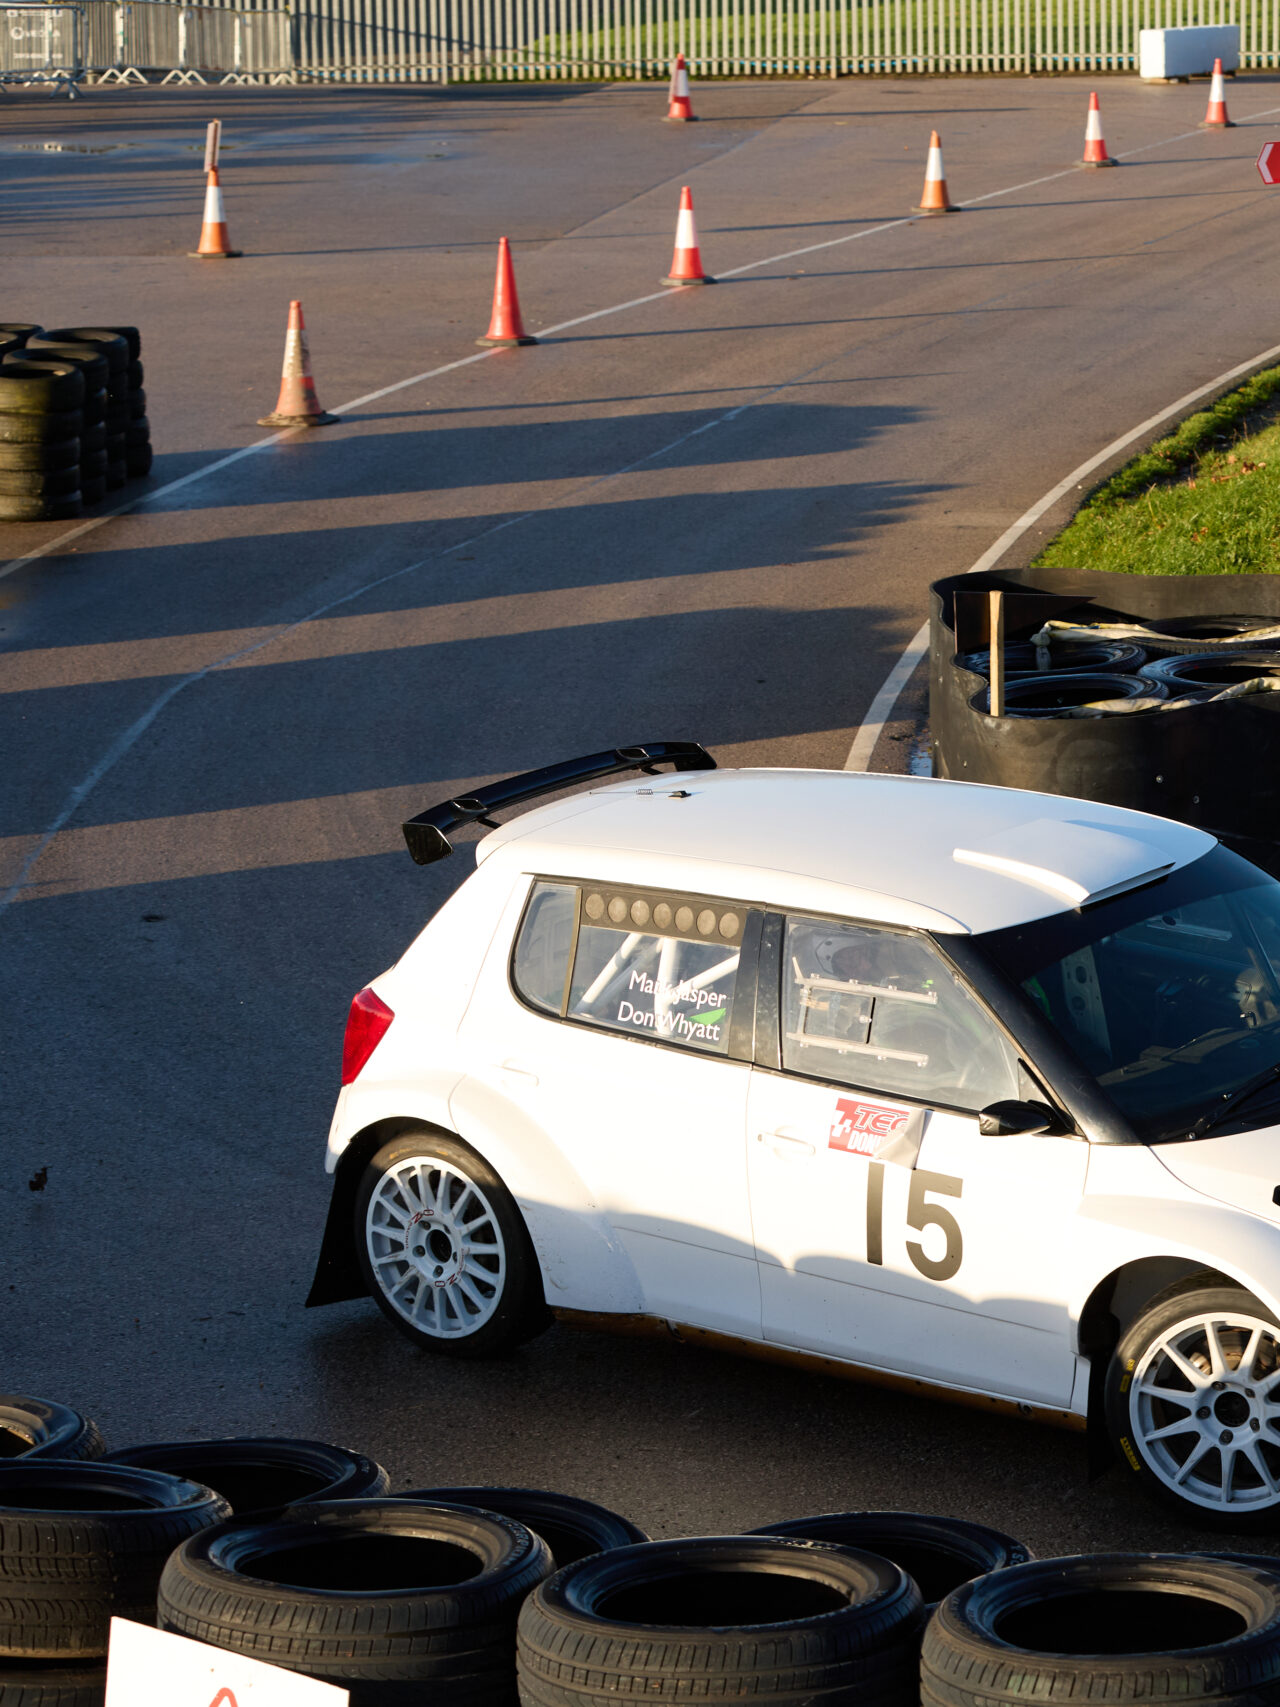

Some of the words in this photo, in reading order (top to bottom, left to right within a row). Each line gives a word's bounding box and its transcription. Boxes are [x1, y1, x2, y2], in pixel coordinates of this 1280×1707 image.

[617, 1000, 655, 1028] Don
[656, 1010, 721, 1042] Whyatt
[866, 1161, 964, 1282] 15
